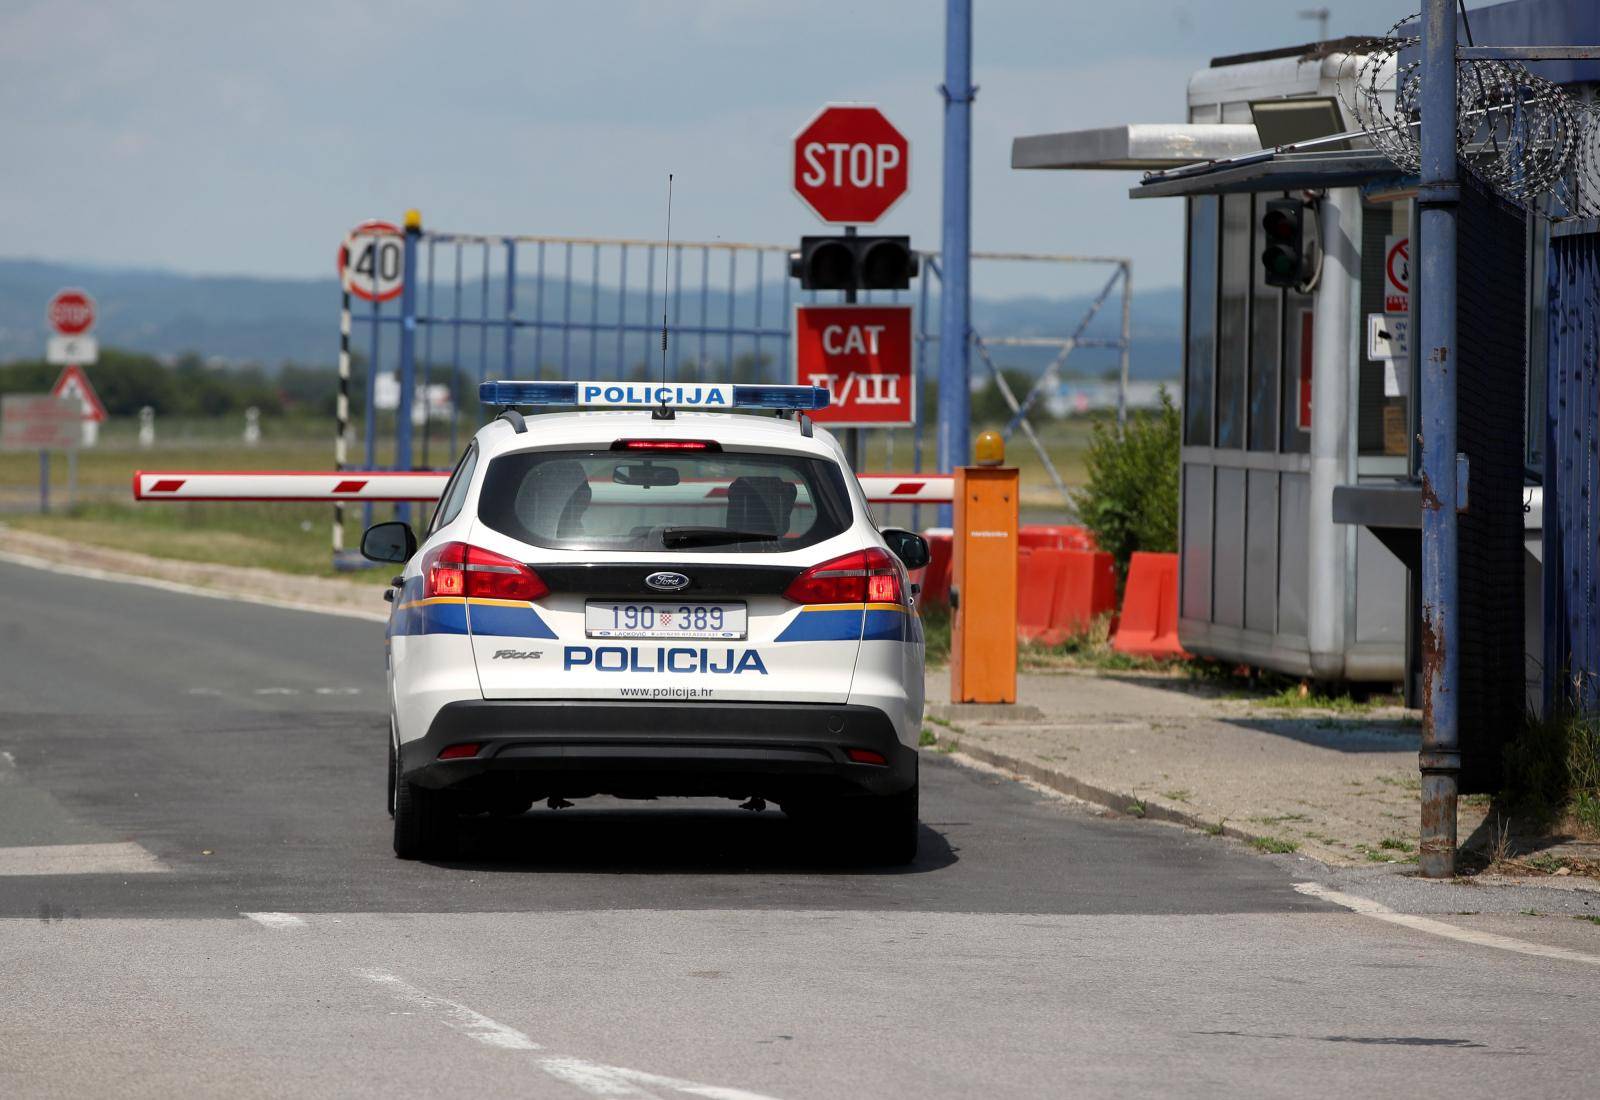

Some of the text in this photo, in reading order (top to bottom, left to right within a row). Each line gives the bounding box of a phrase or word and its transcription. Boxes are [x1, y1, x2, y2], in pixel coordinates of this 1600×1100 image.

[802, 142, 900, 189] STOP
[355, 243, 400, 282] 40
[822, 325, 886, 355] CAT
[584, 386, 725, 405] POLICIJA
[655, 573, 680, 586] Ford
[612, 605, 724, 631] 190 389
[564, 646, 768, 675] POLICIJA
[620, 687, 714, 699] www.policija.hr
